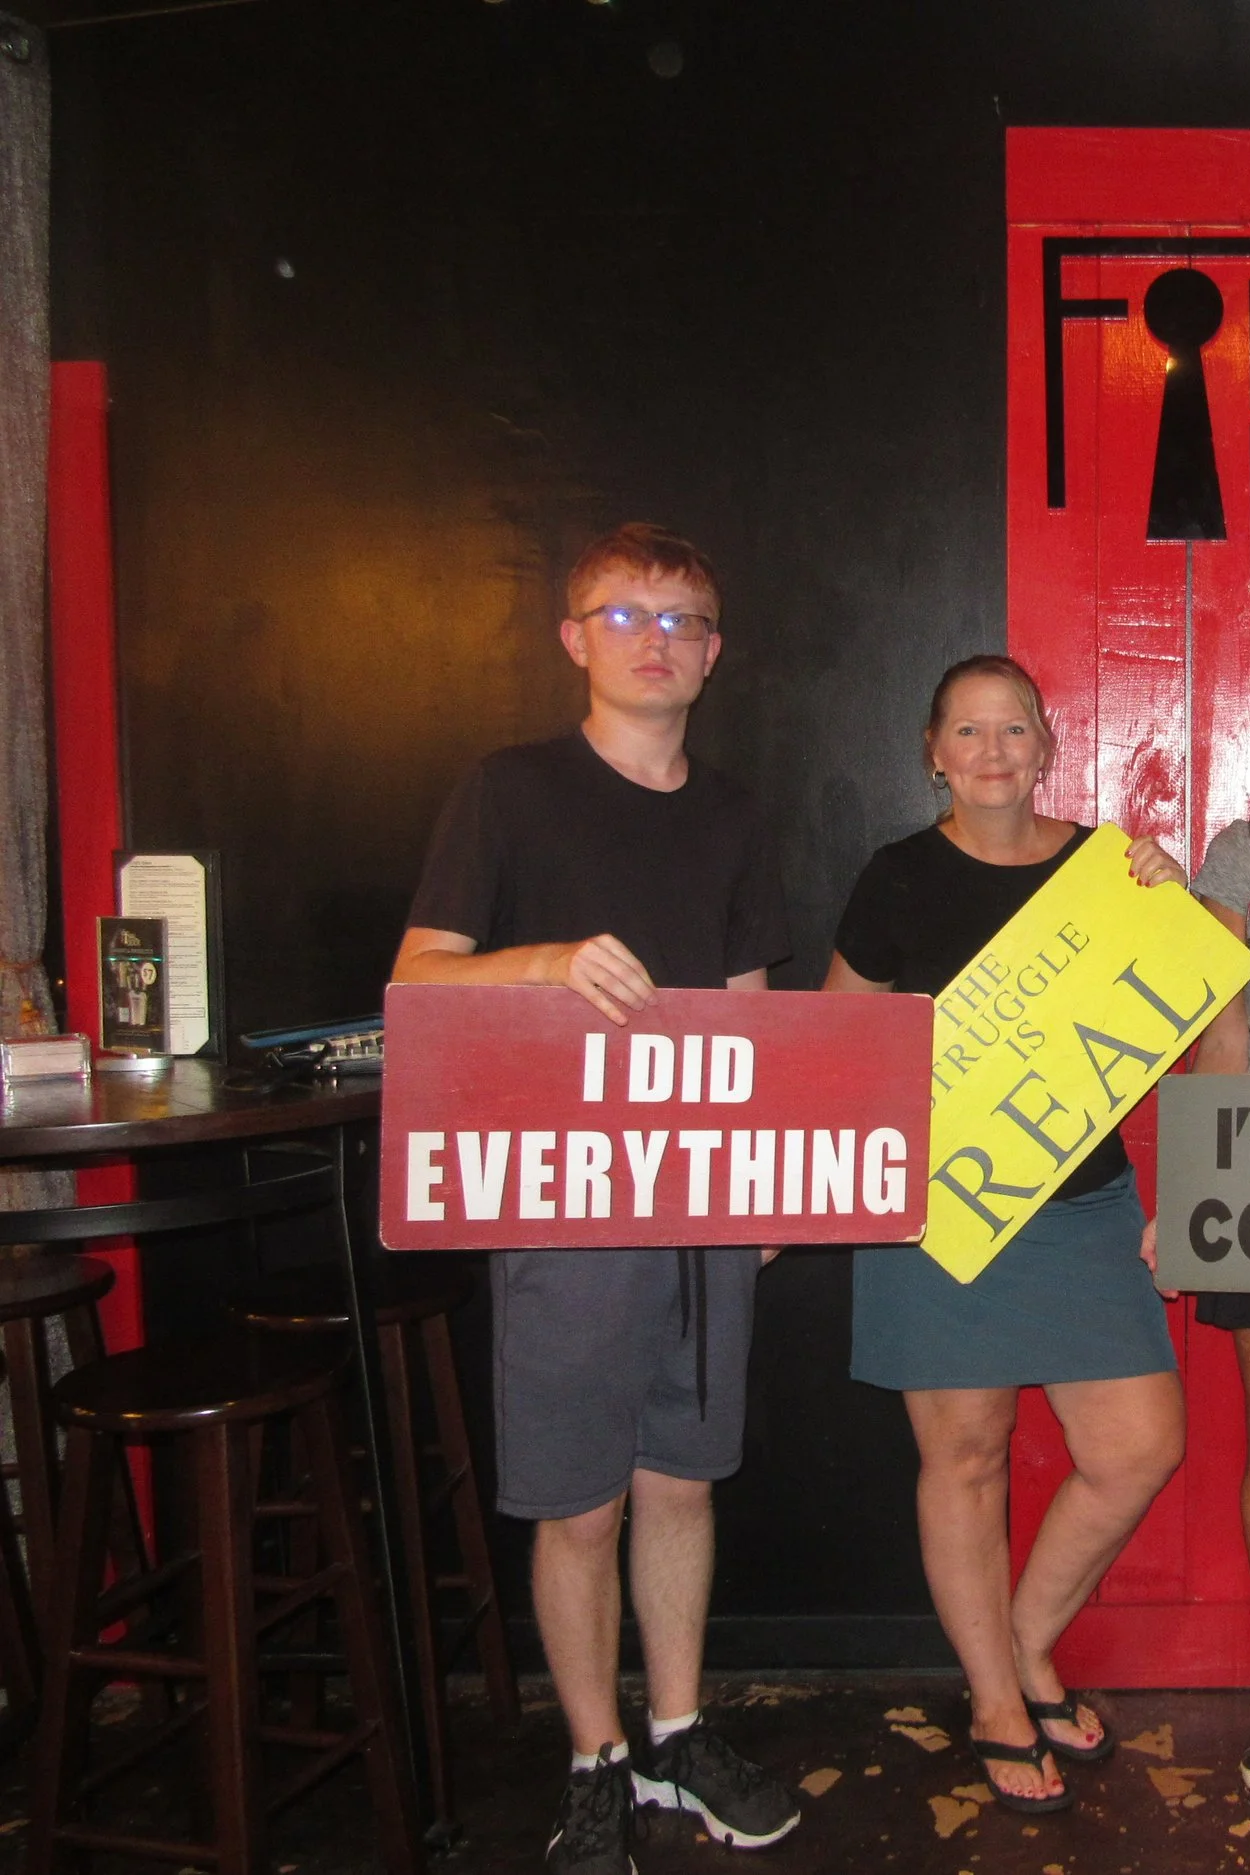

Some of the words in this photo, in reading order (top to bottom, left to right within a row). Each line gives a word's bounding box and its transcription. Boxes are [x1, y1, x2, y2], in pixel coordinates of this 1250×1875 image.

[929, 921, 1090, 1110] TRUGGLE
[936, 953, 1011, 1029] THE
[583, 1032, 606, 1102] I
[628, 1034, 755, 1103] DID
[1004, 1020, 1046, 1062] IS
[929, 958, 1217, 1243] REAL
[407, 1127, 908, 1221] EVERYTHING
